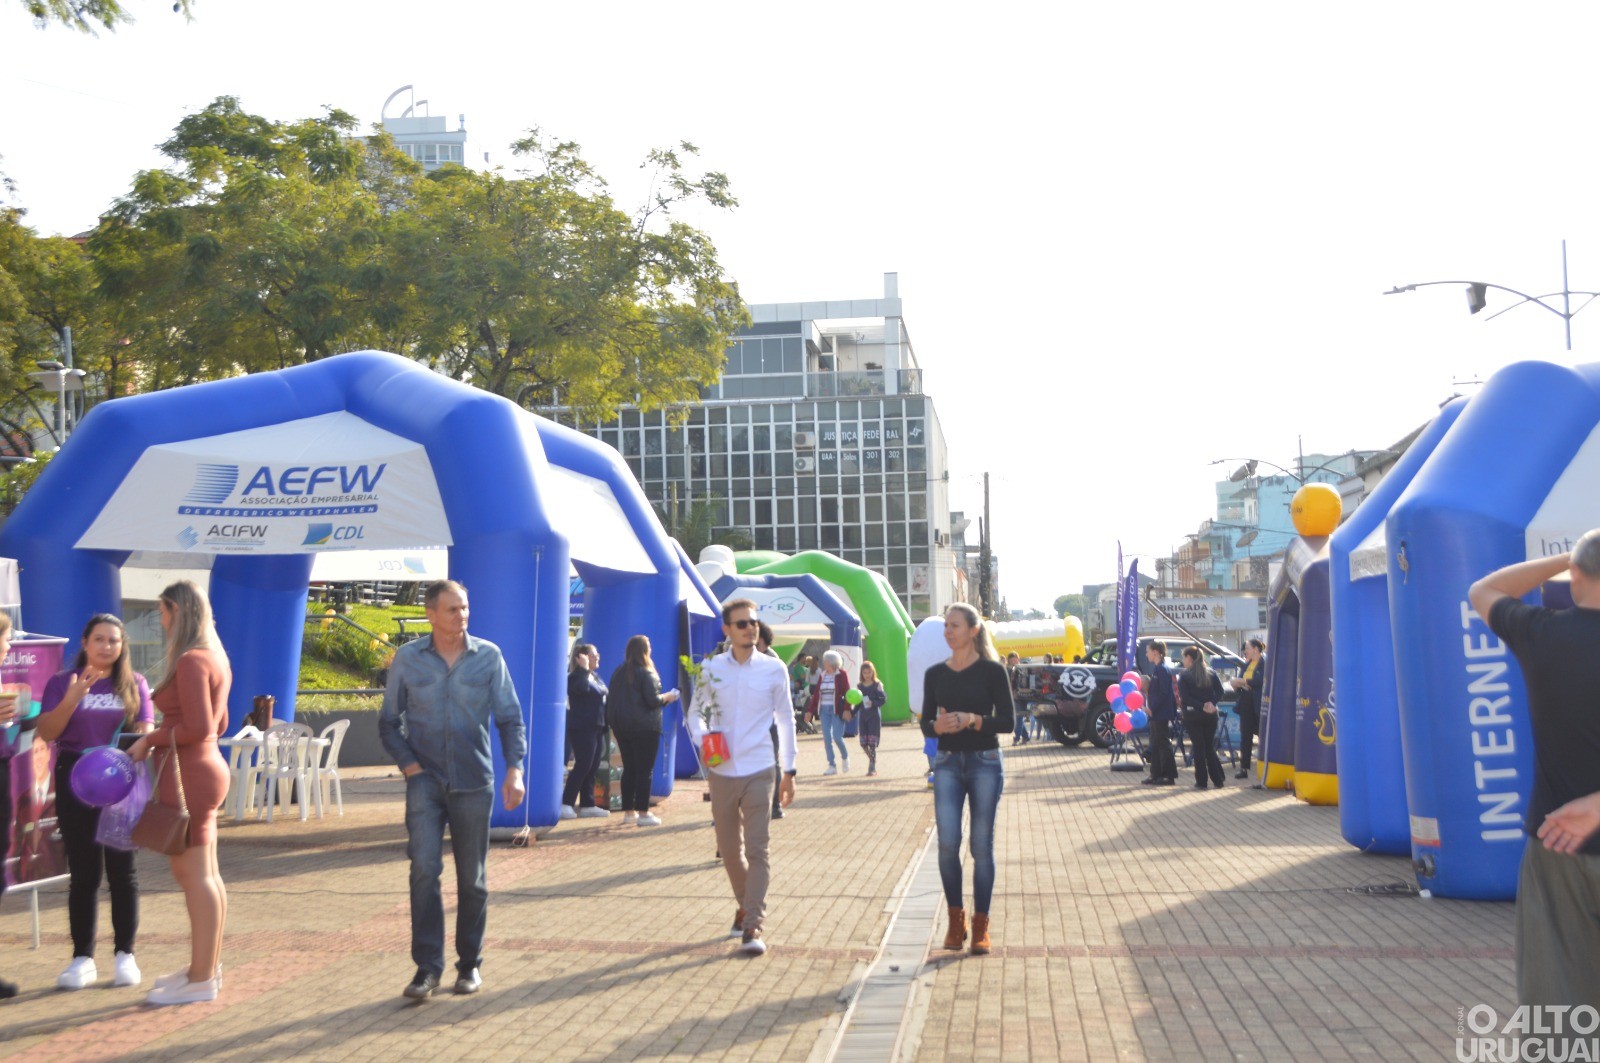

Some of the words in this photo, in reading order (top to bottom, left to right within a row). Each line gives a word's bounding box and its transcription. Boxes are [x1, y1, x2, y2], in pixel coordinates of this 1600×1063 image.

[866, 451, 878, 459] 301
[888, 450, 900, 458] 302
[241, 463, 387, 496] AEFW
[240, 495, 309, 505] ASSOCIAÇÃO
[311, 494, 379, 504] EMPRESARIAL
[205, 509, 283, 517] FREDERICO
[288, 506, 376, 517] WESTPHALEN
[207, 524, 268, 538] ACIFW
[333, 525, 365, 540] CDL
[777, 603, 794, 611] RS
[1460, 600, 1523, 840] INTERNET
